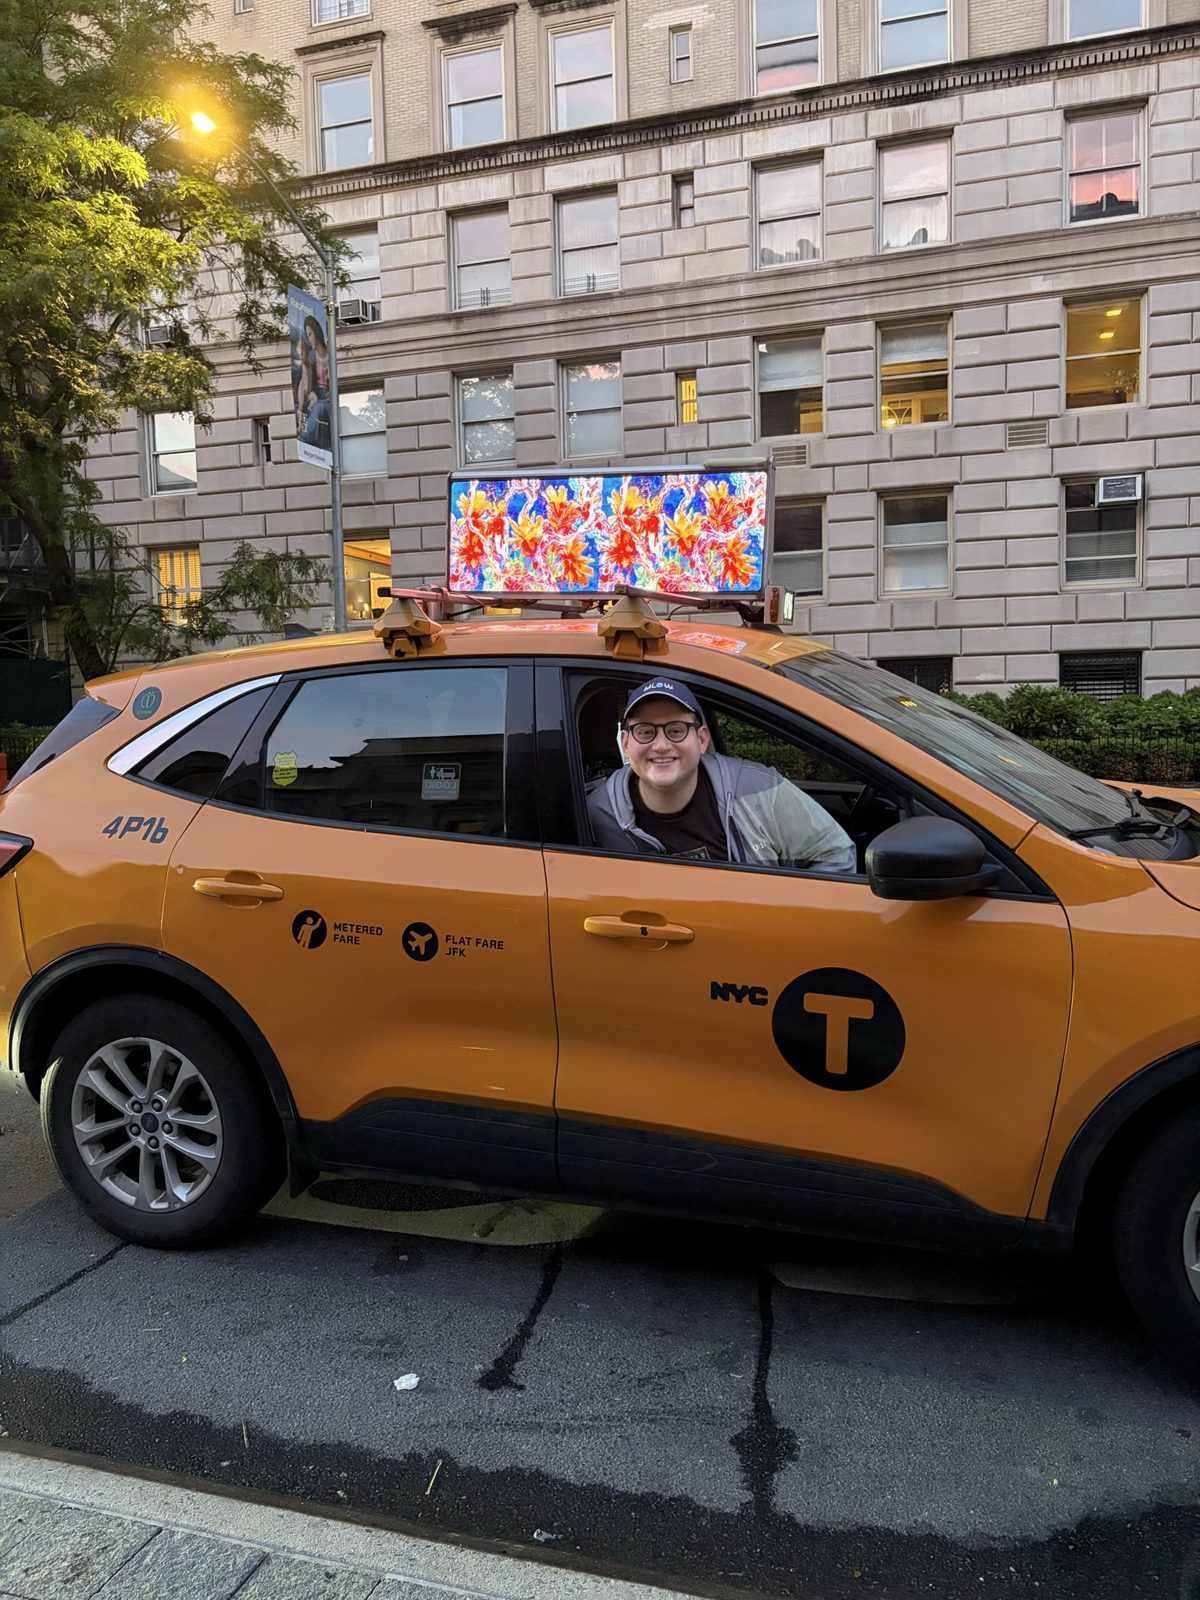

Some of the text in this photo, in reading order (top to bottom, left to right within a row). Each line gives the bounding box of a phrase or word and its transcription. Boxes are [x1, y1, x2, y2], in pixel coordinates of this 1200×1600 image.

[333, 922, 383, 936] METERED
[333, 934, 361, 945] FARE
[445, 935, 504, 950] FLAT FARE
[445, 947, 466, 957] JFK
[710, 981, 874, 1075] NYC T
